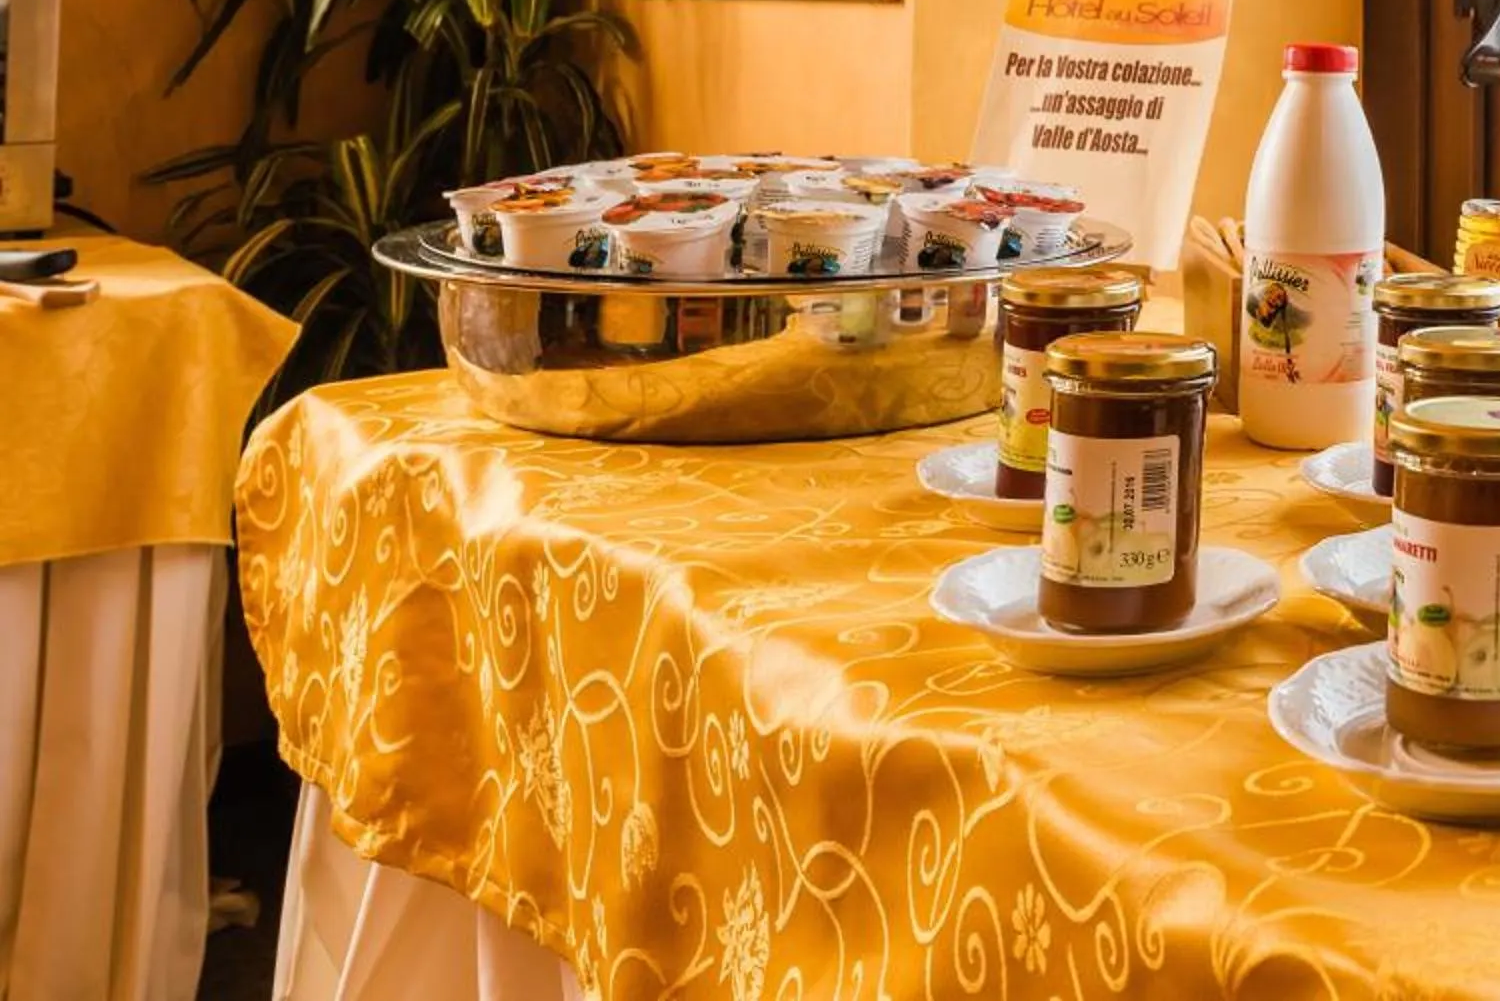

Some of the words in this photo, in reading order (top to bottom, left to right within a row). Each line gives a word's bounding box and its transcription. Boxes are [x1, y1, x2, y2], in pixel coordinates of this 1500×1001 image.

[1134, 1, 1213, 27] Soleil
[1005, 52, 1034, 77] Per
[1035, 54, 1053, 78] la
[1055, 55, 1109, 81] Vostra
[1145, 97, 1164, 120] di
[1032, 125, 1075, 151] Valle
